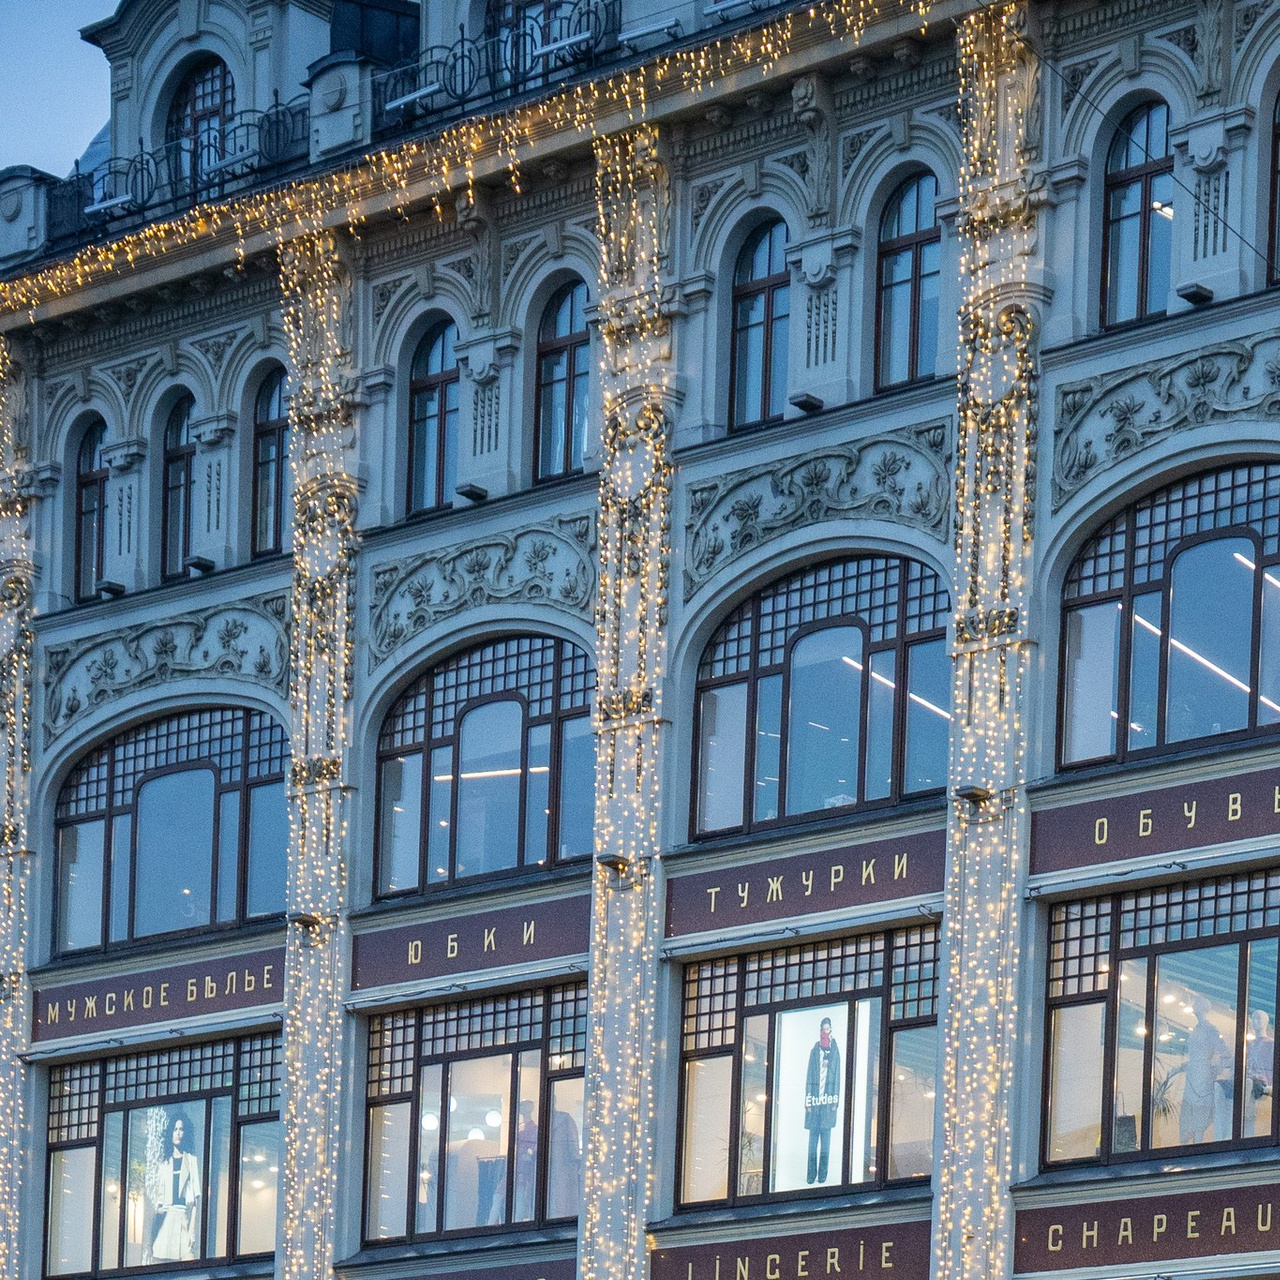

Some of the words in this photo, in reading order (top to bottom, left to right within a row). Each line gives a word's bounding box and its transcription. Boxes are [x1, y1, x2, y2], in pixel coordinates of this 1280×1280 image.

[707, 853, 907, 912] ТУЖУРКИ
[408, 920, 535, 964] ЮБКИ
[48, 983, 170, 1024] МУЖСКОЕ
[804, 1093, 839, 1107] Études
